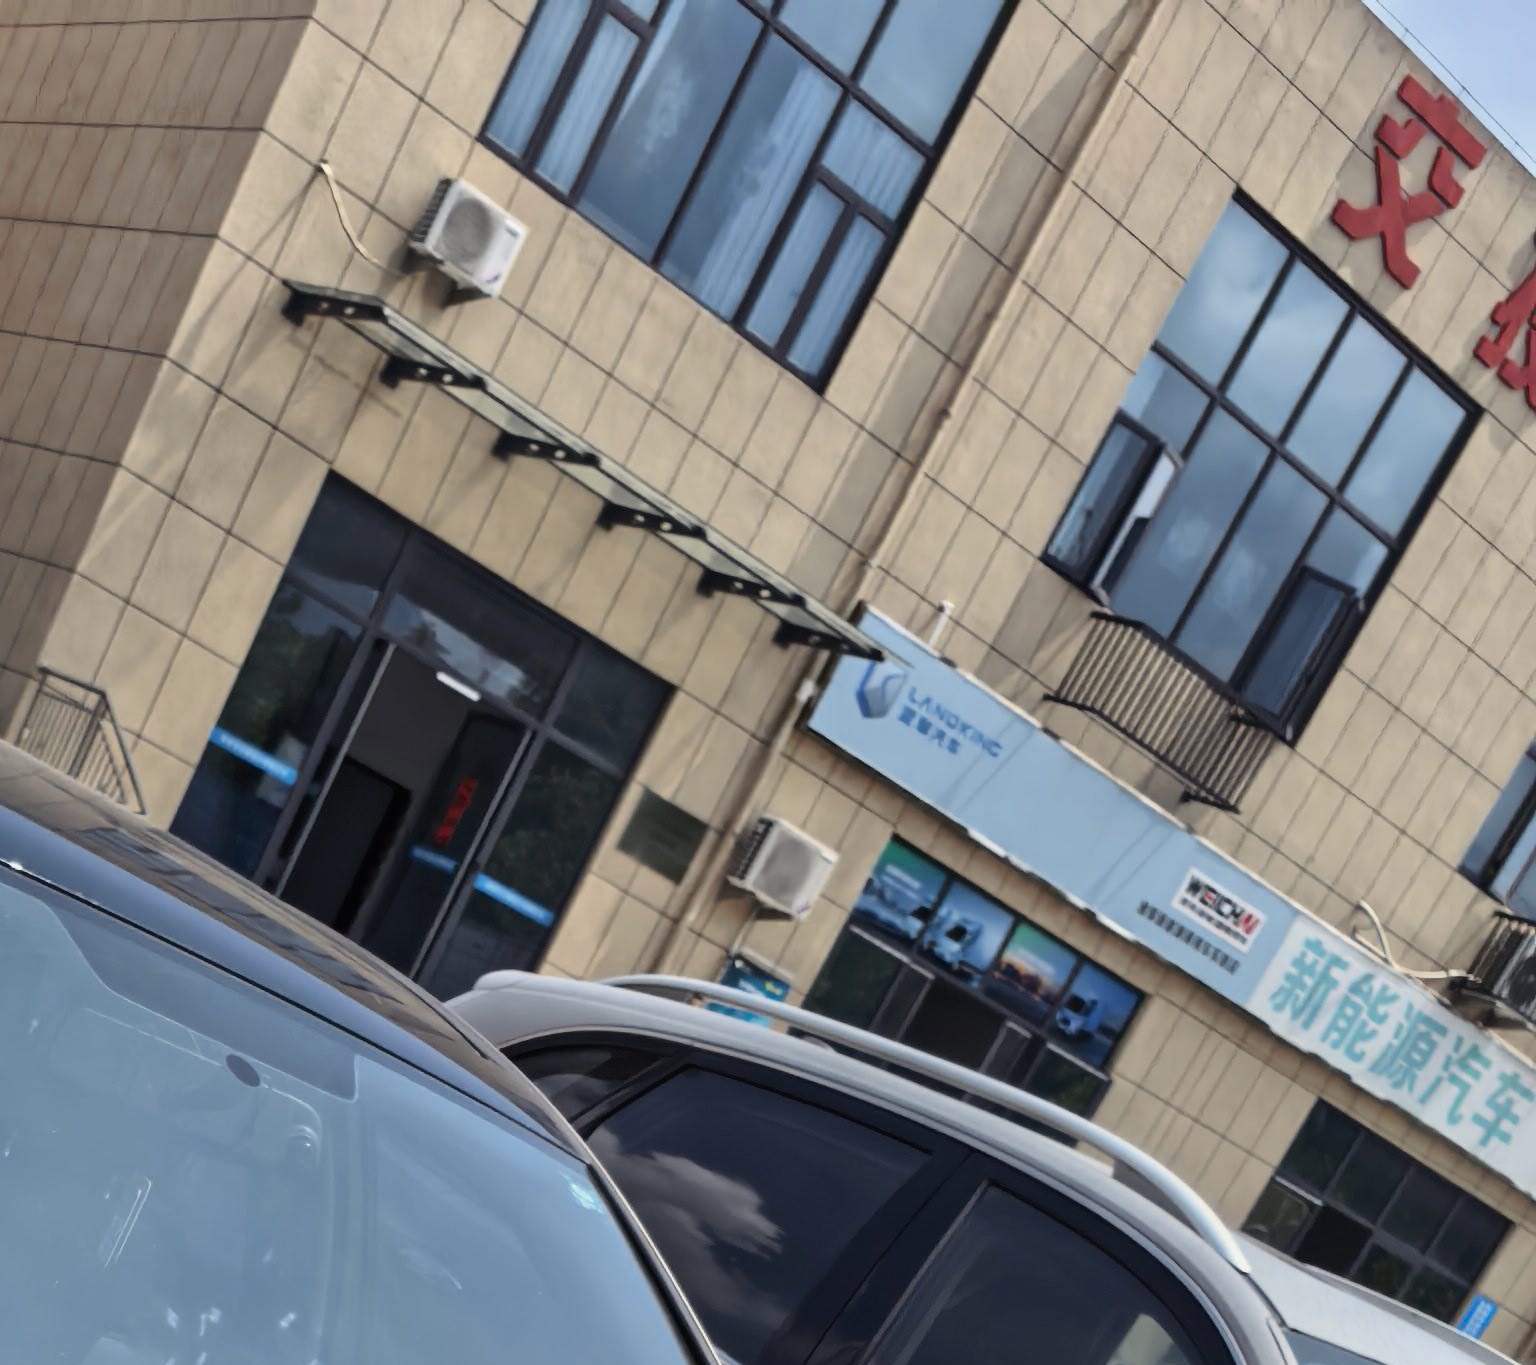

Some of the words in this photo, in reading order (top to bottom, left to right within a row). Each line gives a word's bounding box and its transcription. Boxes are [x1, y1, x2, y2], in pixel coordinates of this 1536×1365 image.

[1268, 936, 1536, 1147] 新能源汽车
